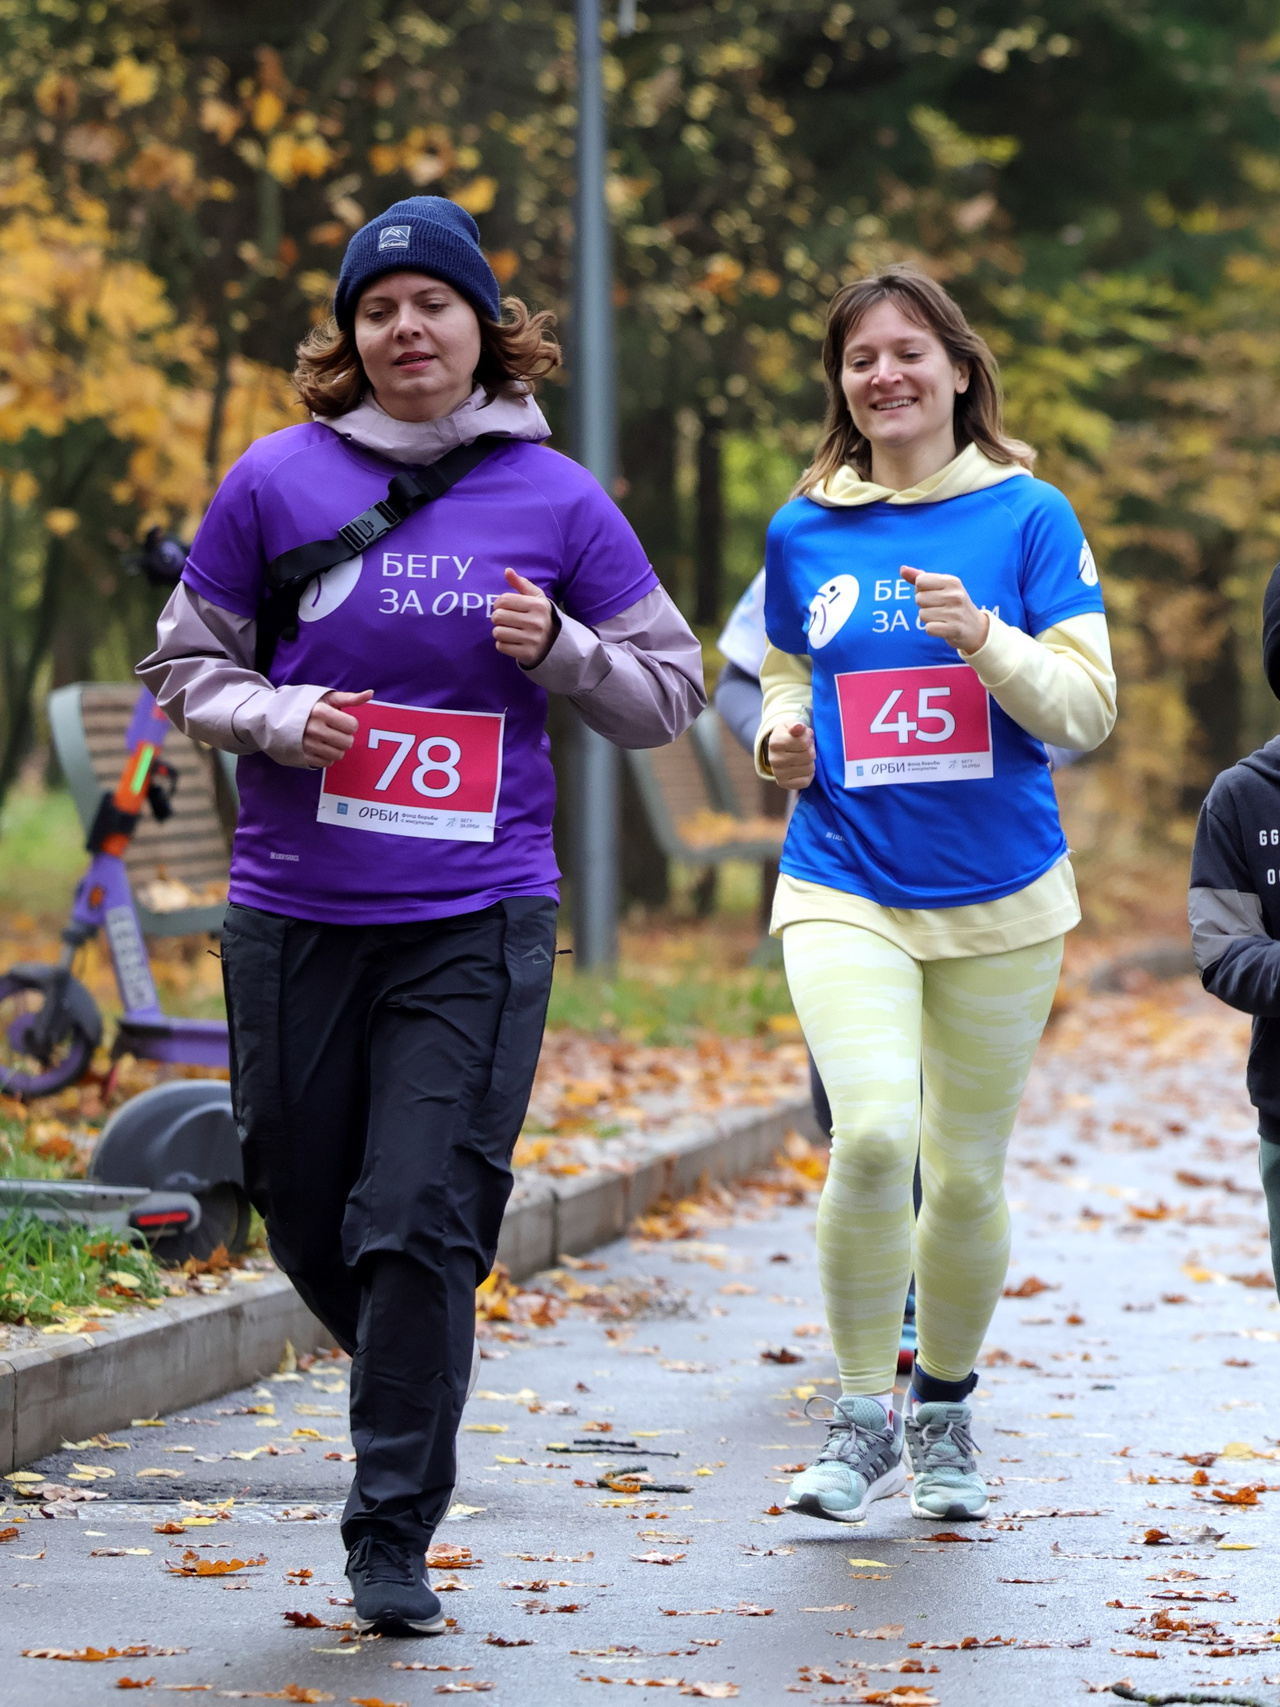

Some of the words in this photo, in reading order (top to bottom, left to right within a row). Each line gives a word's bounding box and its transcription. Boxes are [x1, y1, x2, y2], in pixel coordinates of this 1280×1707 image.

[382, 552, 474, 580] БЕГУ
[874, 579, 911, 601] БЕ
[378, 588, 425, 615] ЗА
[431, 591, 500, 619] ОР
[871, 610, 910, 633] ЗА
[870, 686, 956, 744] 45
[367, 728, 462, 798] 78
[871, 762, 906, 775] ОРБИ
[358, 806, 399, 823] ОРБИ
